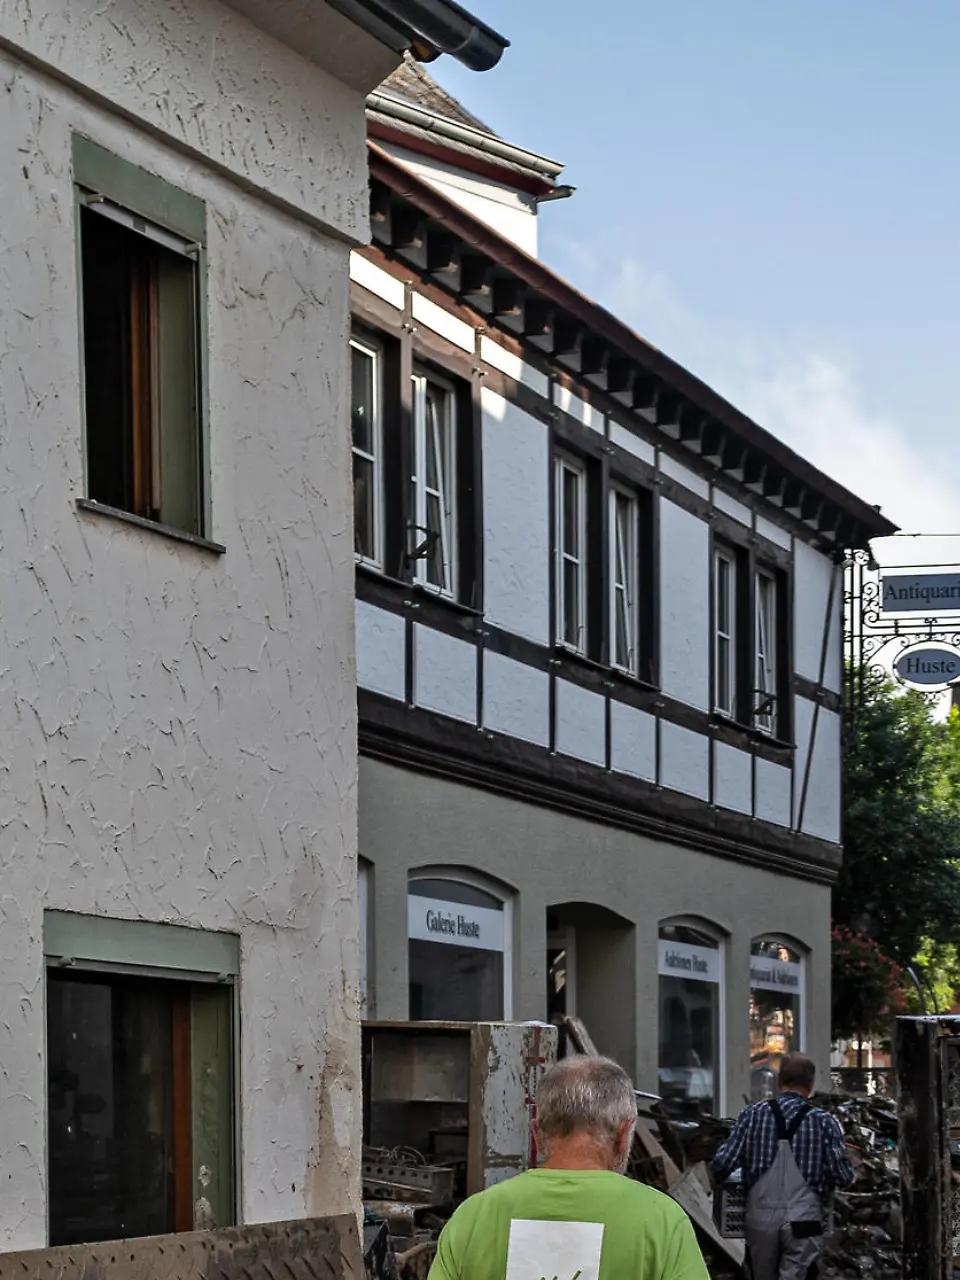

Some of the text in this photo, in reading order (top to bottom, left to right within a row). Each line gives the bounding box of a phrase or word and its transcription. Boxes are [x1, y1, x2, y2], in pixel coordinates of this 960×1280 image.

[906, 657, 957, 674] Huste
[426, 909, 480, 938] Galerie Huste
